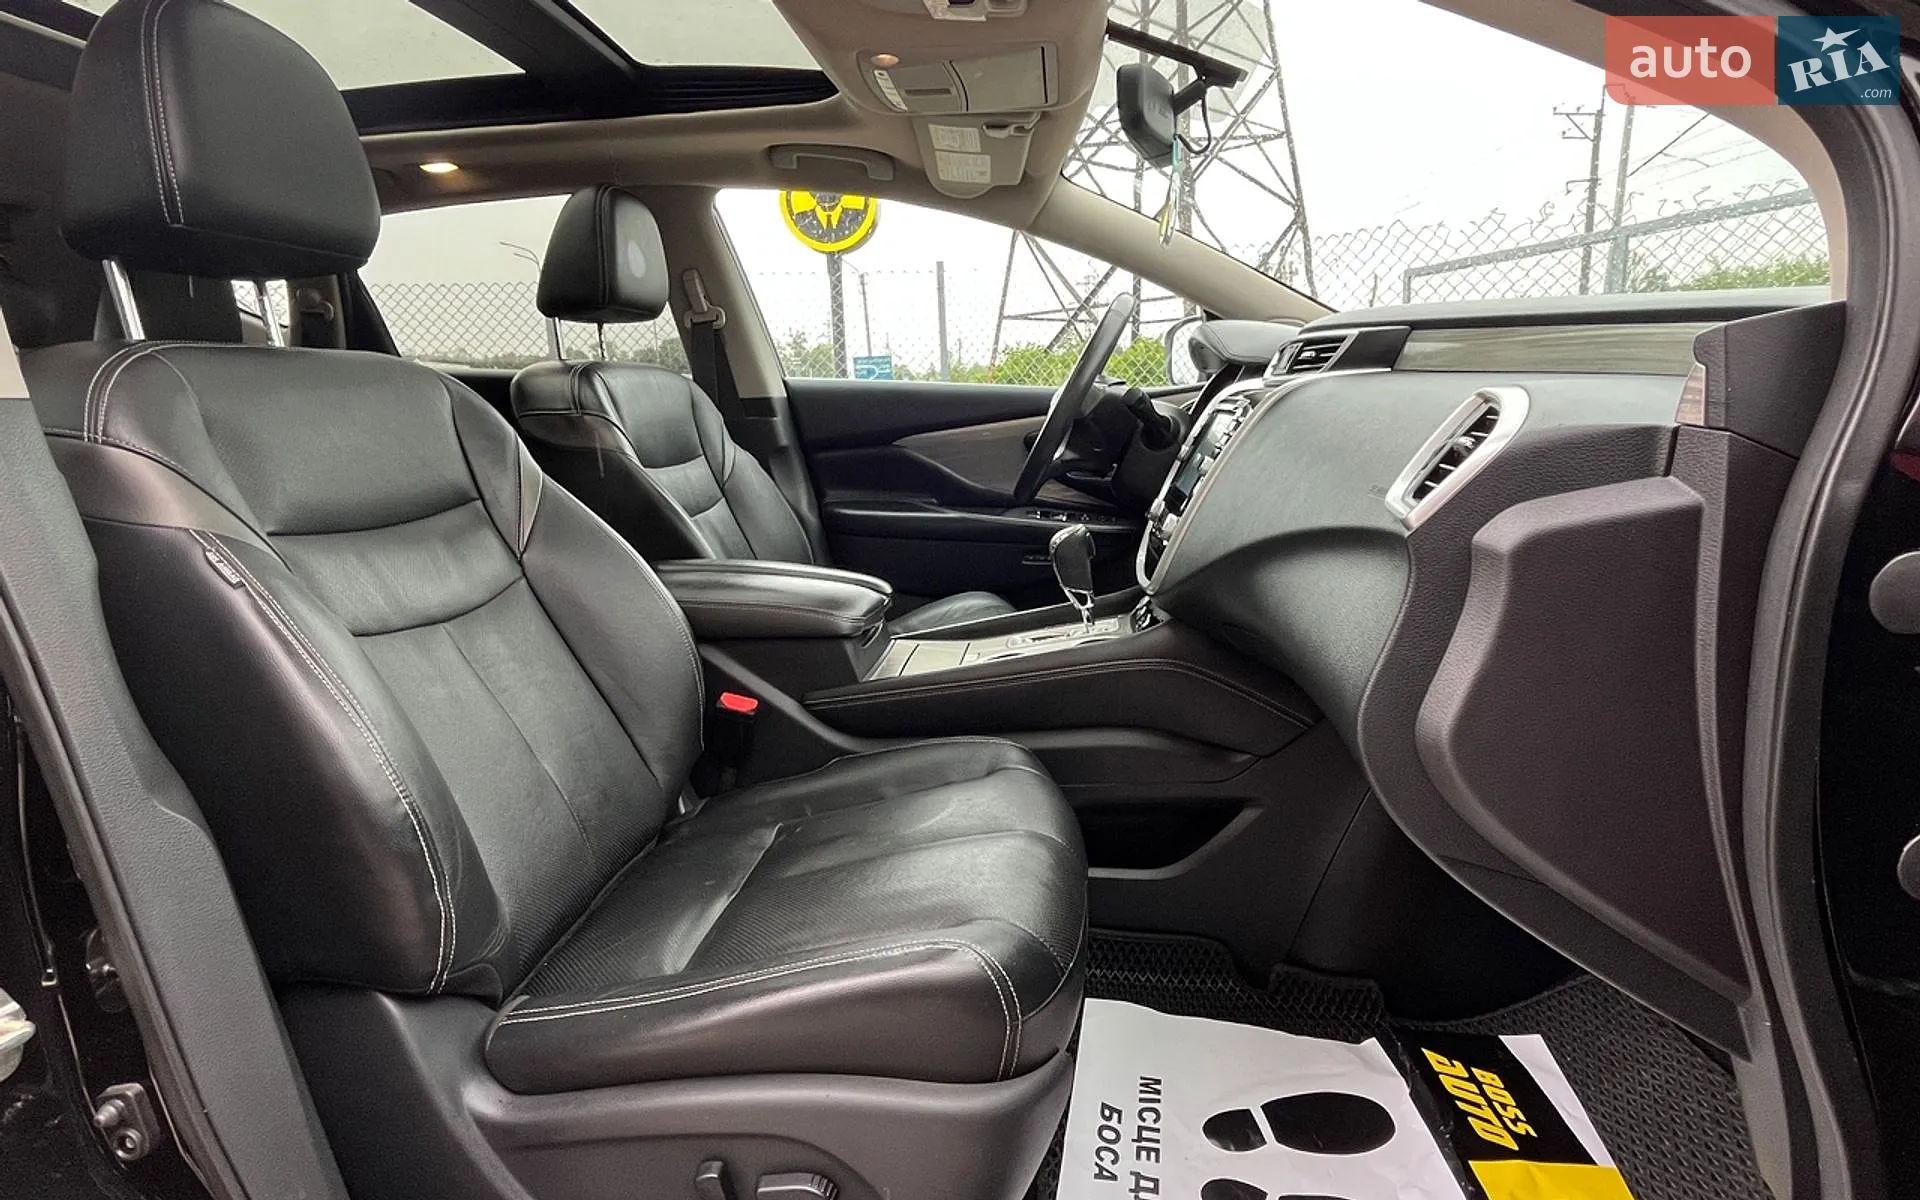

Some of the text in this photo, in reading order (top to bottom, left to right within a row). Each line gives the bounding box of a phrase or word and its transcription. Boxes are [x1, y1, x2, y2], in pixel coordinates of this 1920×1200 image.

[1093, 1101, 1123, 1182] БОСА
[1131, 1076, 1162, 1164] МІСЦЕ
[1470, 1066, 1538, 1138] BOSS
